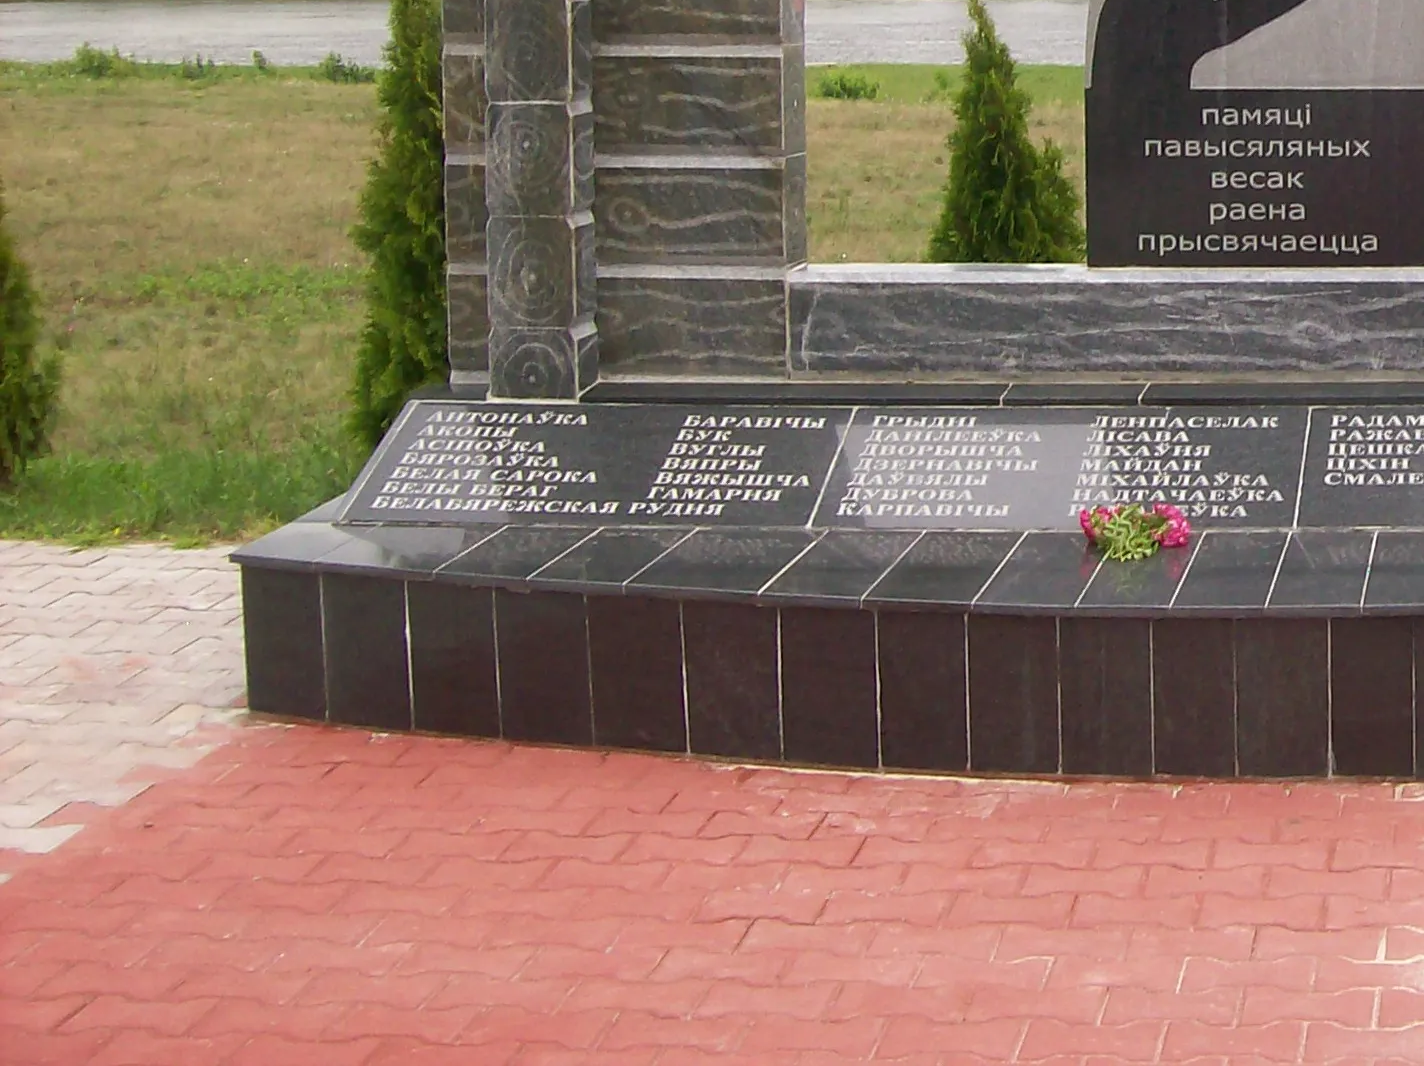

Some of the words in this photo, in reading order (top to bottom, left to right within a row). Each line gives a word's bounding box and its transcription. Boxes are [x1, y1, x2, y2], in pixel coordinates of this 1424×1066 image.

[1201, 103, 1312, 129] памяці
[1144, 138, 1371, 158] павысяляных
[1210, 170, 1305, 189] весак
[1208, 201, 1307, 225] раена
[1137, 233, 1379, 257] прысвячаецца
[426, 410, 589, 426] АНТОНАЎКА
[682, 414, 827, 429] БАРАВІЧЫ
[1090, 415, 1280, 429] ЛЕНПАСЕЛАК
[416, 424, 518, 438] АКОПЫ
[675, 428, 732, 442] БУК
[1086, 429, 1190, 443] ЛІСАВА
[407, 438, 546, 453] АСІПОЎКА
[668, 442, 767, 457] ВУГЛЫ
[858, 443, 1024, 458] ДВОРЫШЧА
[1082, 442, 1212, 457] ЛІХАЎНЯ
[399, 452, 559, 468] БЯРОЗАЎКА
[660, 457, 763, 471] ВЯПРЫ
[853, 457, 1040, 472] ДЗЕРНАВІЧЫ
[1079, 456, 1203, 472] МАЙДАН
[1325, 457, 1411, 473] ЦІХІН
[389, 467, 481, 481] БЕЛАЯ
[490, 469, 598, 483] САРОКА
[653, 471, 811, 487] ВЯЖЫШЧА
[1075, 470, 1270, 487] МІХАЙЛАЎКА
[380, 481, 461, 495] БЕЛЫ
[468, 484, 559, 497] БЕРАГ
[646, 486, 783, 502] ГАМАРНЯ
[840, 486, 974, 503] ДУБРОВА
[1070, 486, 1285, 502] НАДТАЧАЕЎКА
[369, 495, 620, 514] БЕЛАБЯРЕЖСКАЯ
[627, 502, 726, 517] РУДНЯ
[836, 501, 1012, 517] КАРПАВІЧЫ
